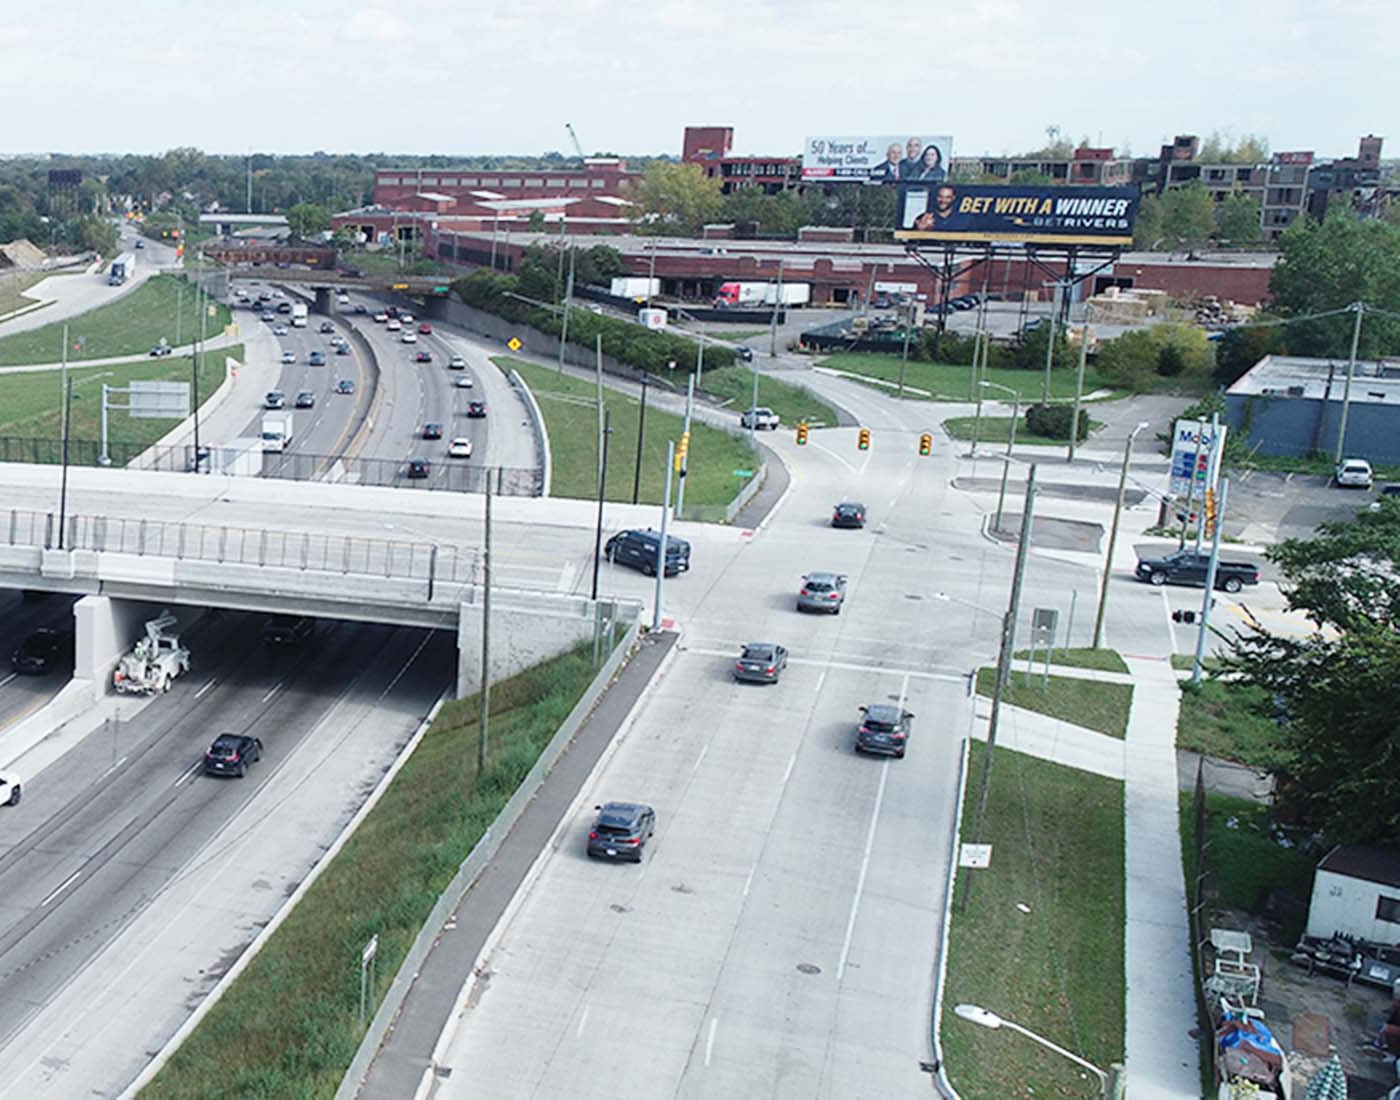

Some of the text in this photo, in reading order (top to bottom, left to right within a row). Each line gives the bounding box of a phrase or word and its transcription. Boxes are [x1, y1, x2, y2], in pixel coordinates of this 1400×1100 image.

[811, 140, 826, 154] 50
[828, 140, 854, 154] Years
[959, 196, 1128, 216] BET WITH A WINNER
[1033, 217, 1129, 229] BETRIVERS
[1180, 430, 1217, 446] Mob
